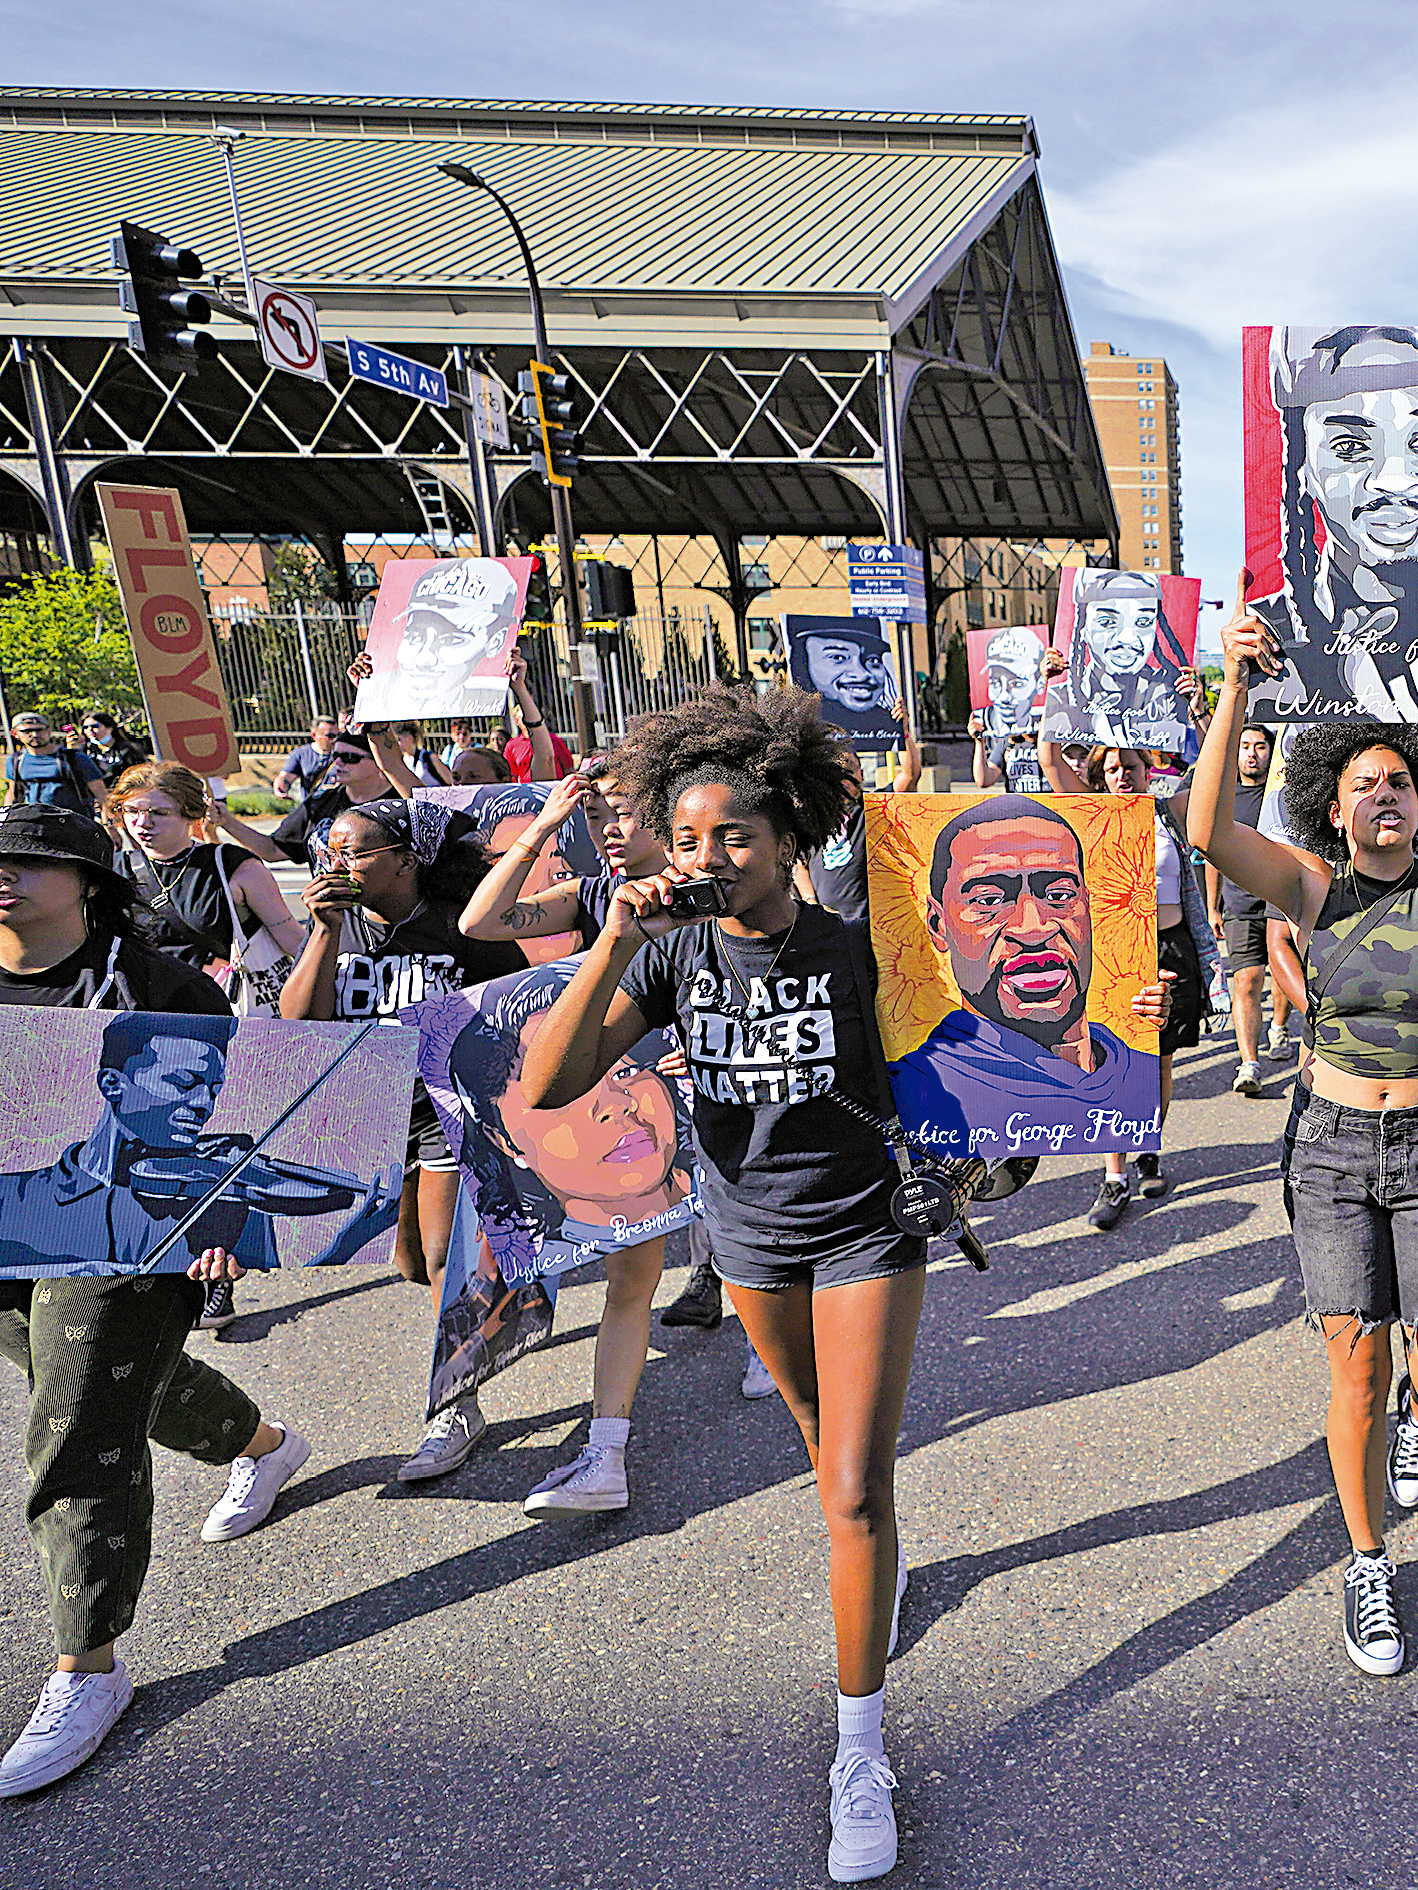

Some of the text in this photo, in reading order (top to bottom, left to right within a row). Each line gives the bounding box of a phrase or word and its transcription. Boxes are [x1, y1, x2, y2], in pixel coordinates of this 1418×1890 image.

[357, 350, 439, 396] S 5th Av
[853, 567, 902, 576] Public Parking
[110, 490, 230, 774] FLOYD
[156, 616, 188, 633] BLM
[1323, 628, 1402, 656] Justice
[1275, 685, 1406, 718] Winston
[690, 968, 832, 1013] BLACK
[699, 1017, 821, 1059] LIVES
[690, 1064, 836, 1105] MATTER
[968, 1126, 1000, 1153] for
[1004, 1111, 1077, 1151] George
[1083, 1107, 1161, 1146] Floyd
[903, 1185, 924, 1198] PYLE
[571, 1239, 600, 1266] for
[609, 1214, 682, 1243] Breonna
